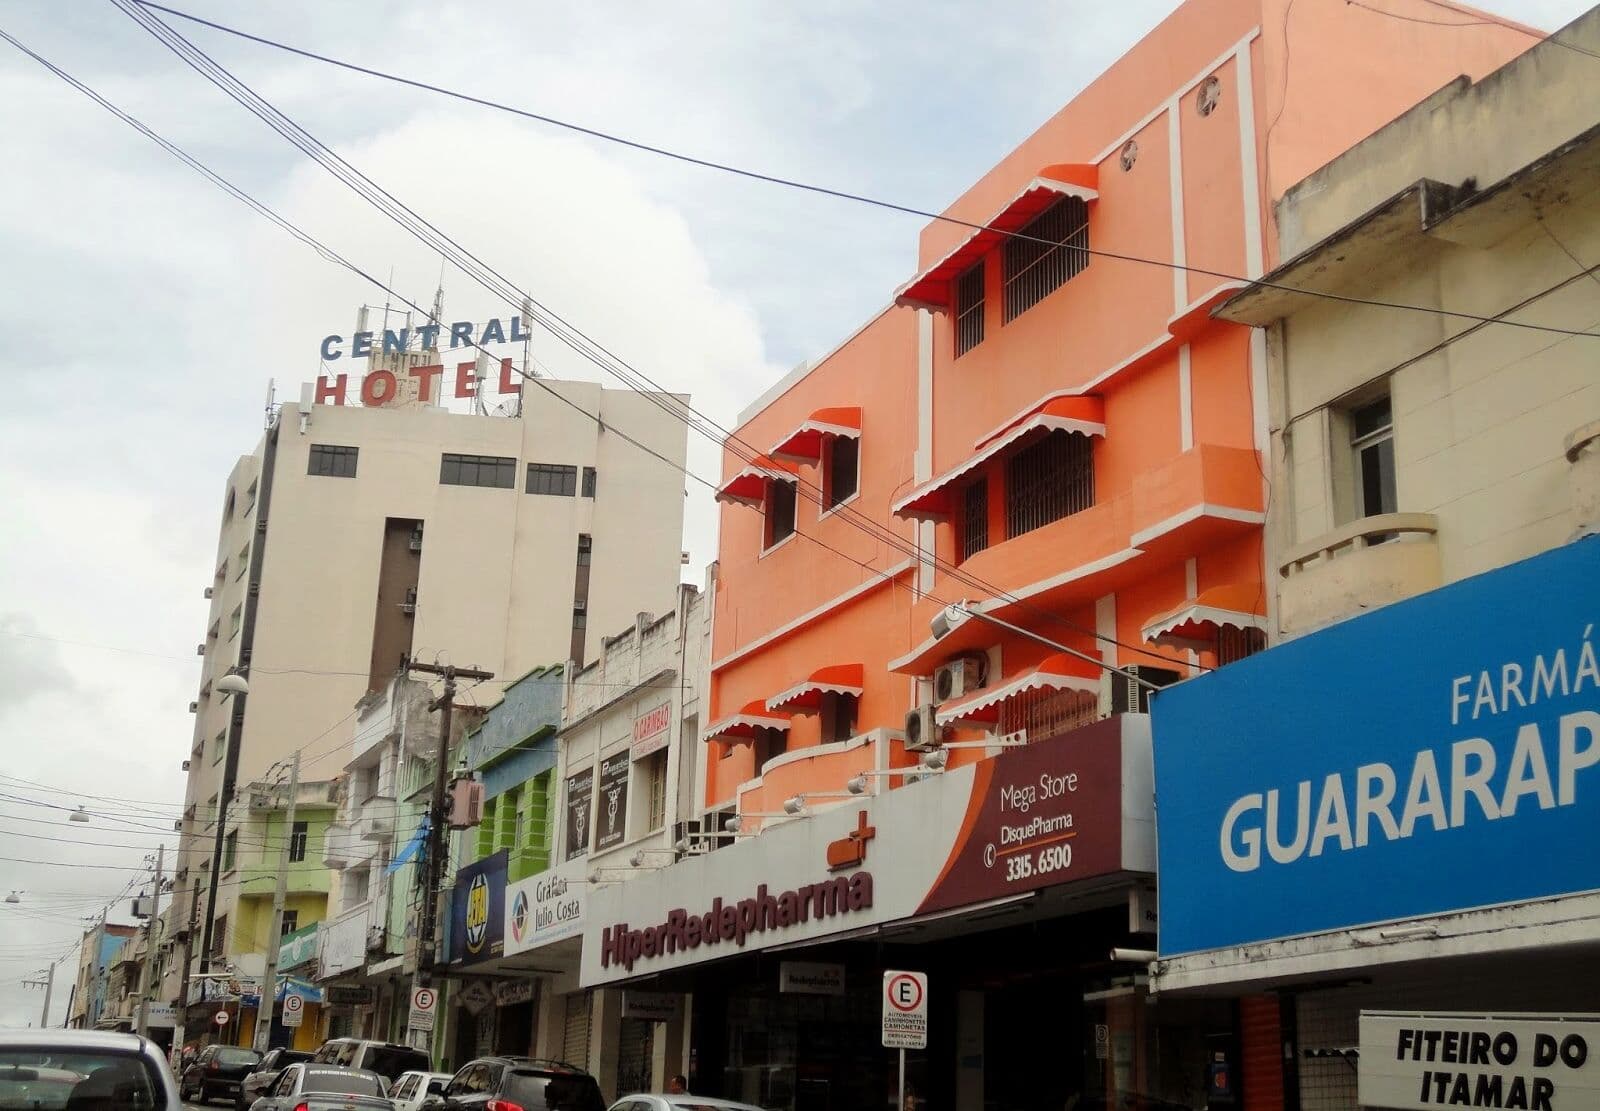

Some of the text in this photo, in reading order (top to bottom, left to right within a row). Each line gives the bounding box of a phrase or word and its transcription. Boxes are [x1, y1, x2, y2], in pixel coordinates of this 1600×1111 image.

[320, 315, 531, 361] CENTRAL
[314, 357, 522, 407] HOTEL
[1451, 624, 1600, 725] FARMÁ
[1001, 773, 1078, 813] Mega Store
[1219, 710, 1600, 873] GUARARAP
[1001, 814, 1073, 845] DisquePharma
[1006, 844, 1072, 882] 3315.6500
[535, 899, 580, 932] Julio Costa
[601, 871, 873, 972] HiperRedepharma
[291, 998, 297, 1008] E
[420, 993, 428, 1005] E
[900, 982, 911, 1003] E
[1397, 1029, 1588, 1069] FITEIRO DO
[1420, 1071, 1555, 1111] ITAMAR
